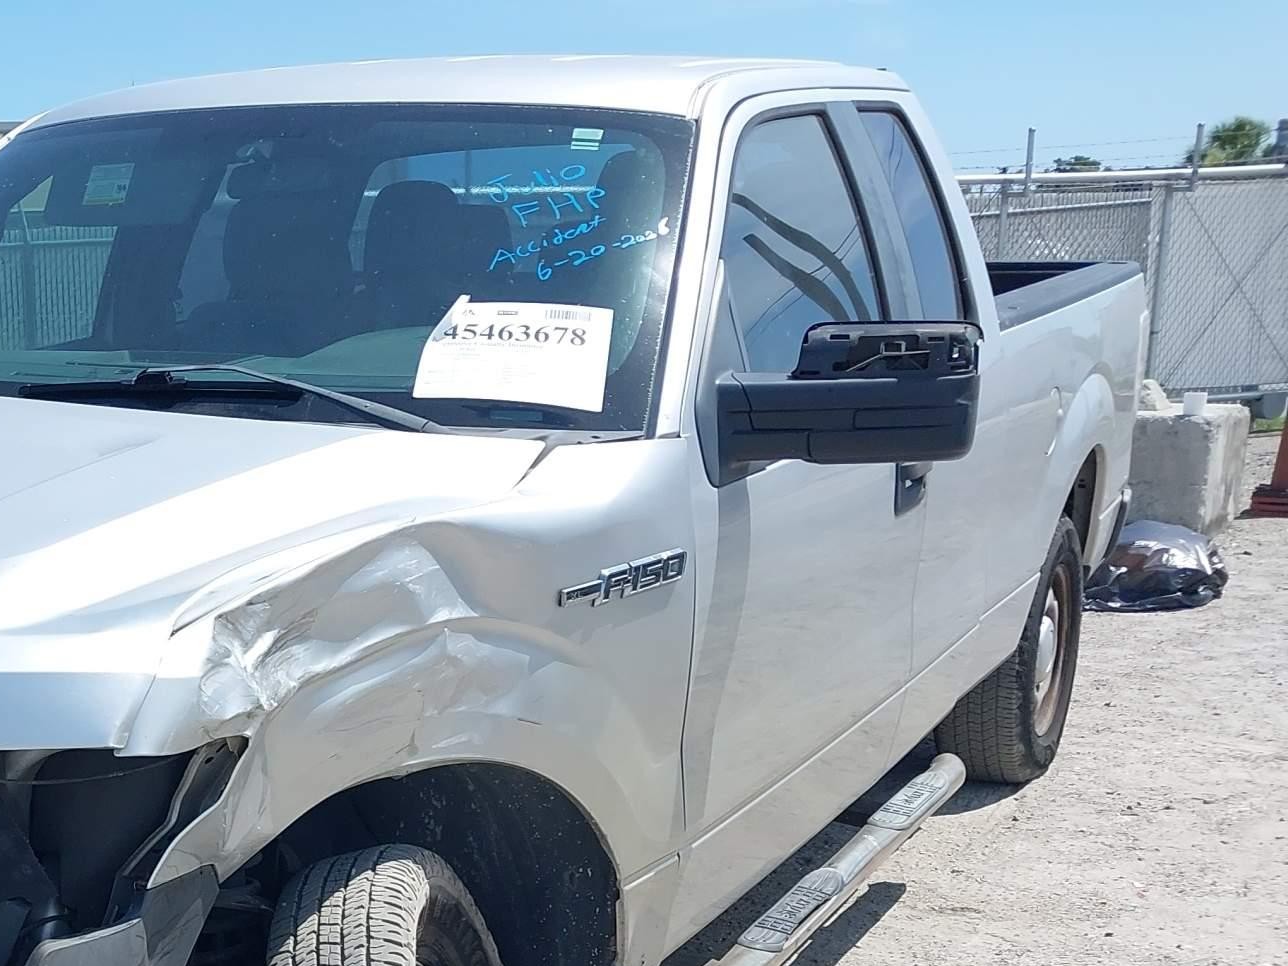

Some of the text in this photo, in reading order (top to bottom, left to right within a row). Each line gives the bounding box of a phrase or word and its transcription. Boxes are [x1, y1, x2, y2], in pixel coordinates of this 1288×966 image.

[512, 187, 606, 228] FHP
[487, 215, 607, 273] Accident
[443, 323, 587, 346] 45463678
